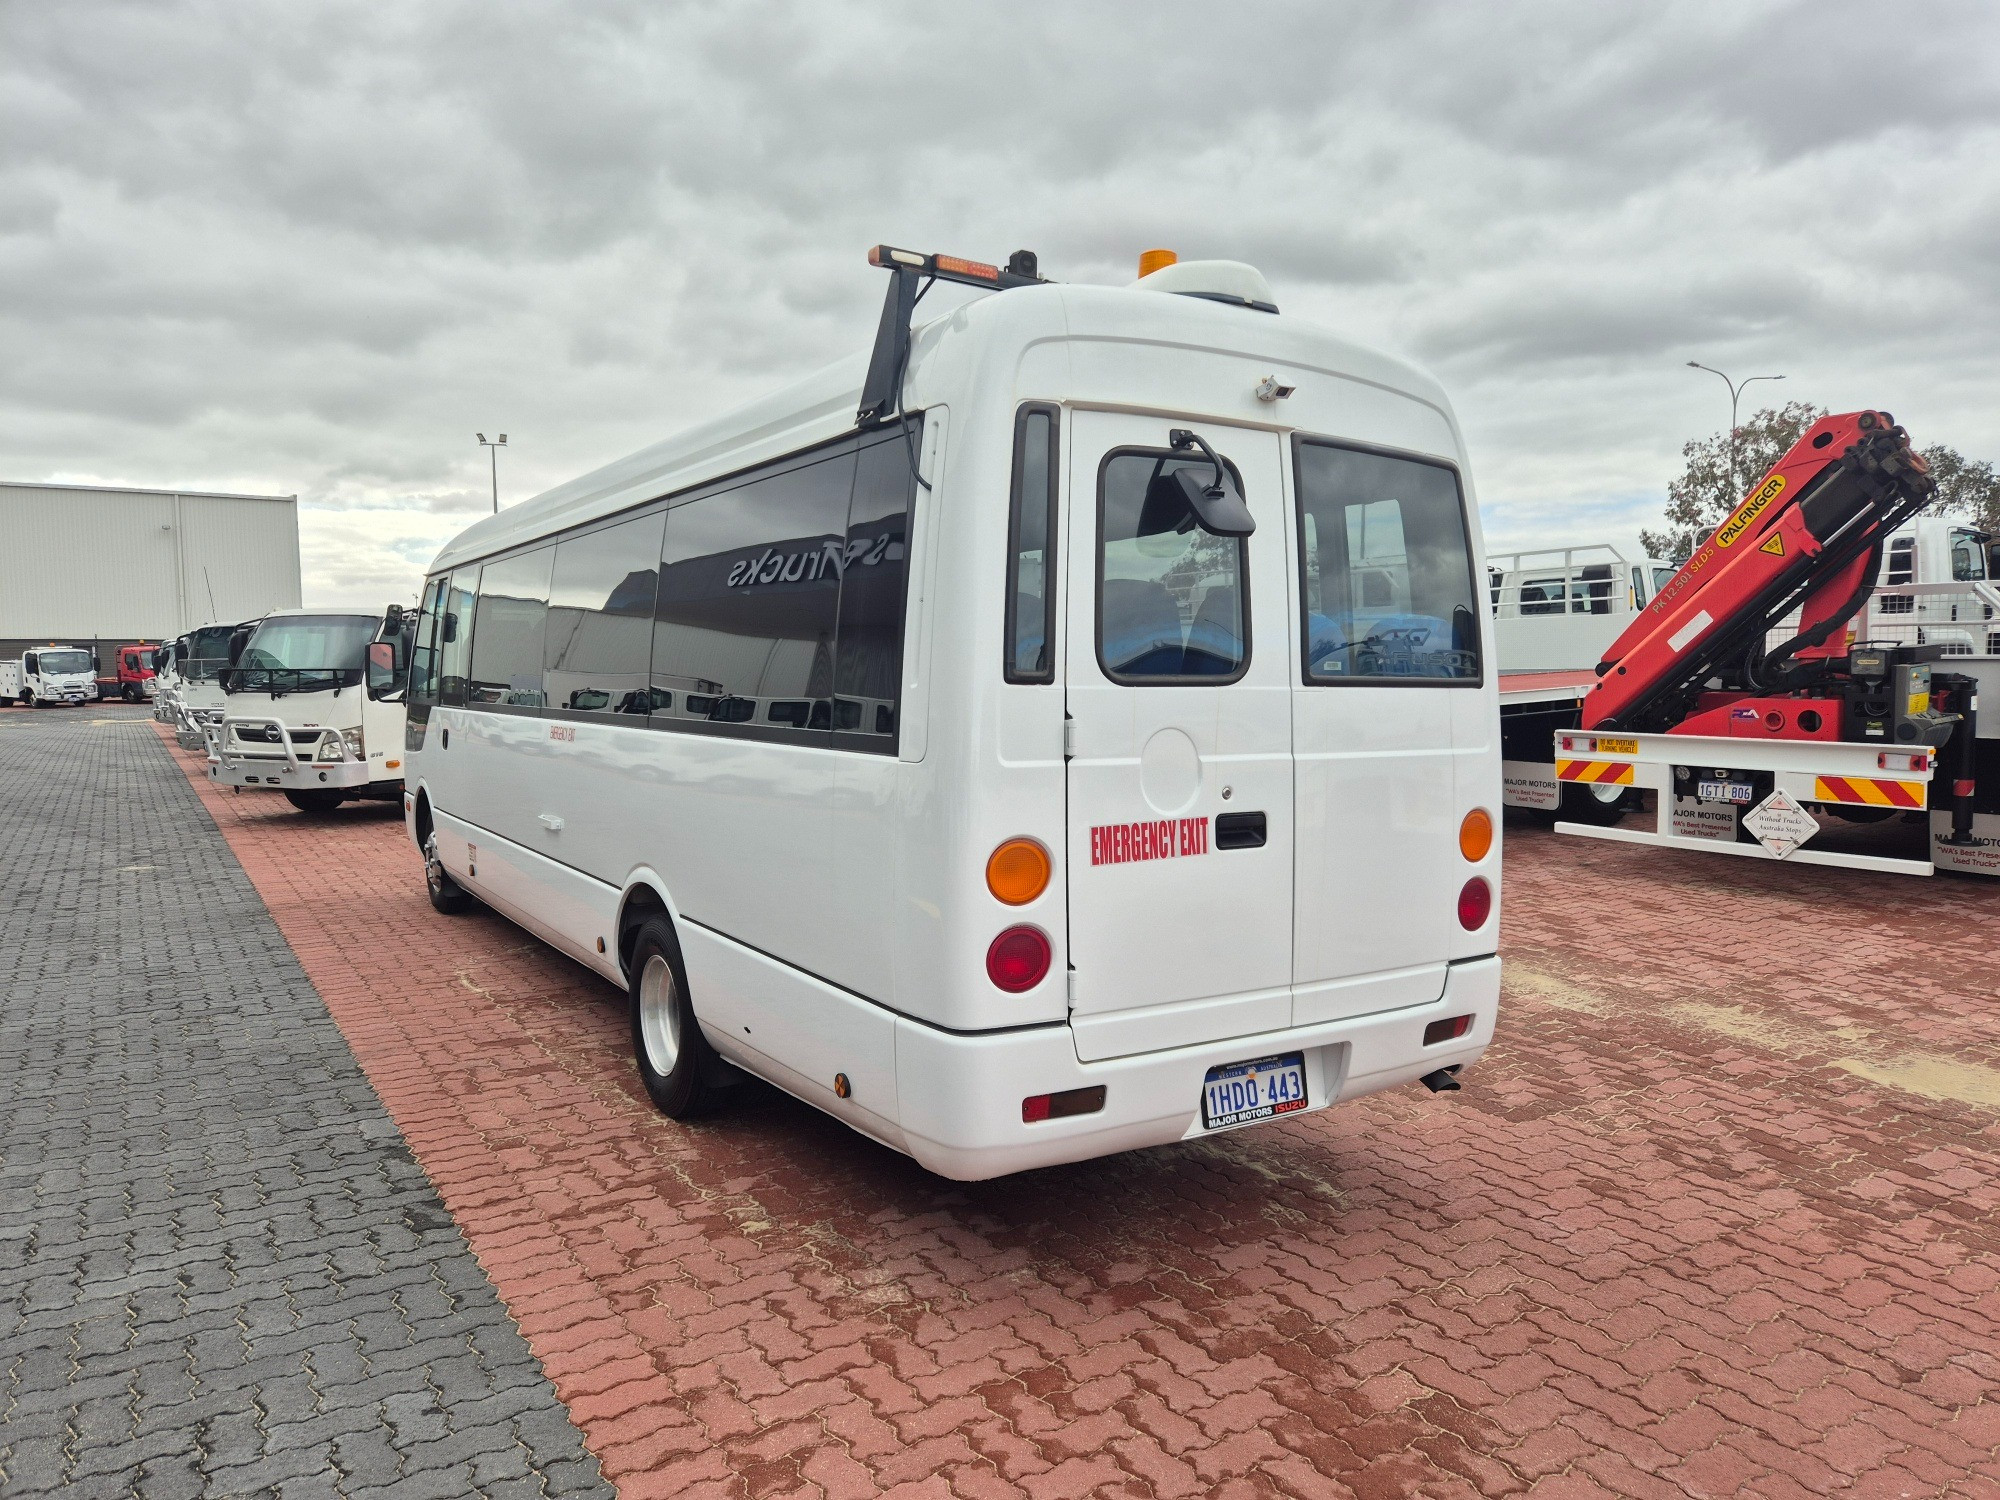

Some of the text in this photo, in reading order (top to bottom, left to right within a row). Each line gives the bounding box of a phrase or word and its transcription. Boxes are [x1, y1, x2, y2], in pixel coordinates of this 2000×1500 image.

[1720, 479, 1783, 544] PALFINGER
[1652, 599, 1667, 614] PK
[1664, 571, 1693, 601] 12.501
[1690, 547, 1714, 573] SLD5
[1393, 651, 1462, 666] FUSO
[1504, 778, 1557, 789] MAJOR MOTORS
[1673, 809, 1733, 822] AJOR MOTORS
[1760, 815, 1781, 823] Without
[1702, 823, 1731, 832] Presented
[1786, 826, 1802, 834] Stops
[1091, 817, 1208, 866] EMERGENCY EXIT
[1960, 849, 1976, 857] Best
[1952, 857, 1970, 865] Used
[1209, 1099, 1307, 1129] MAJOR MOTORS ISUZU
